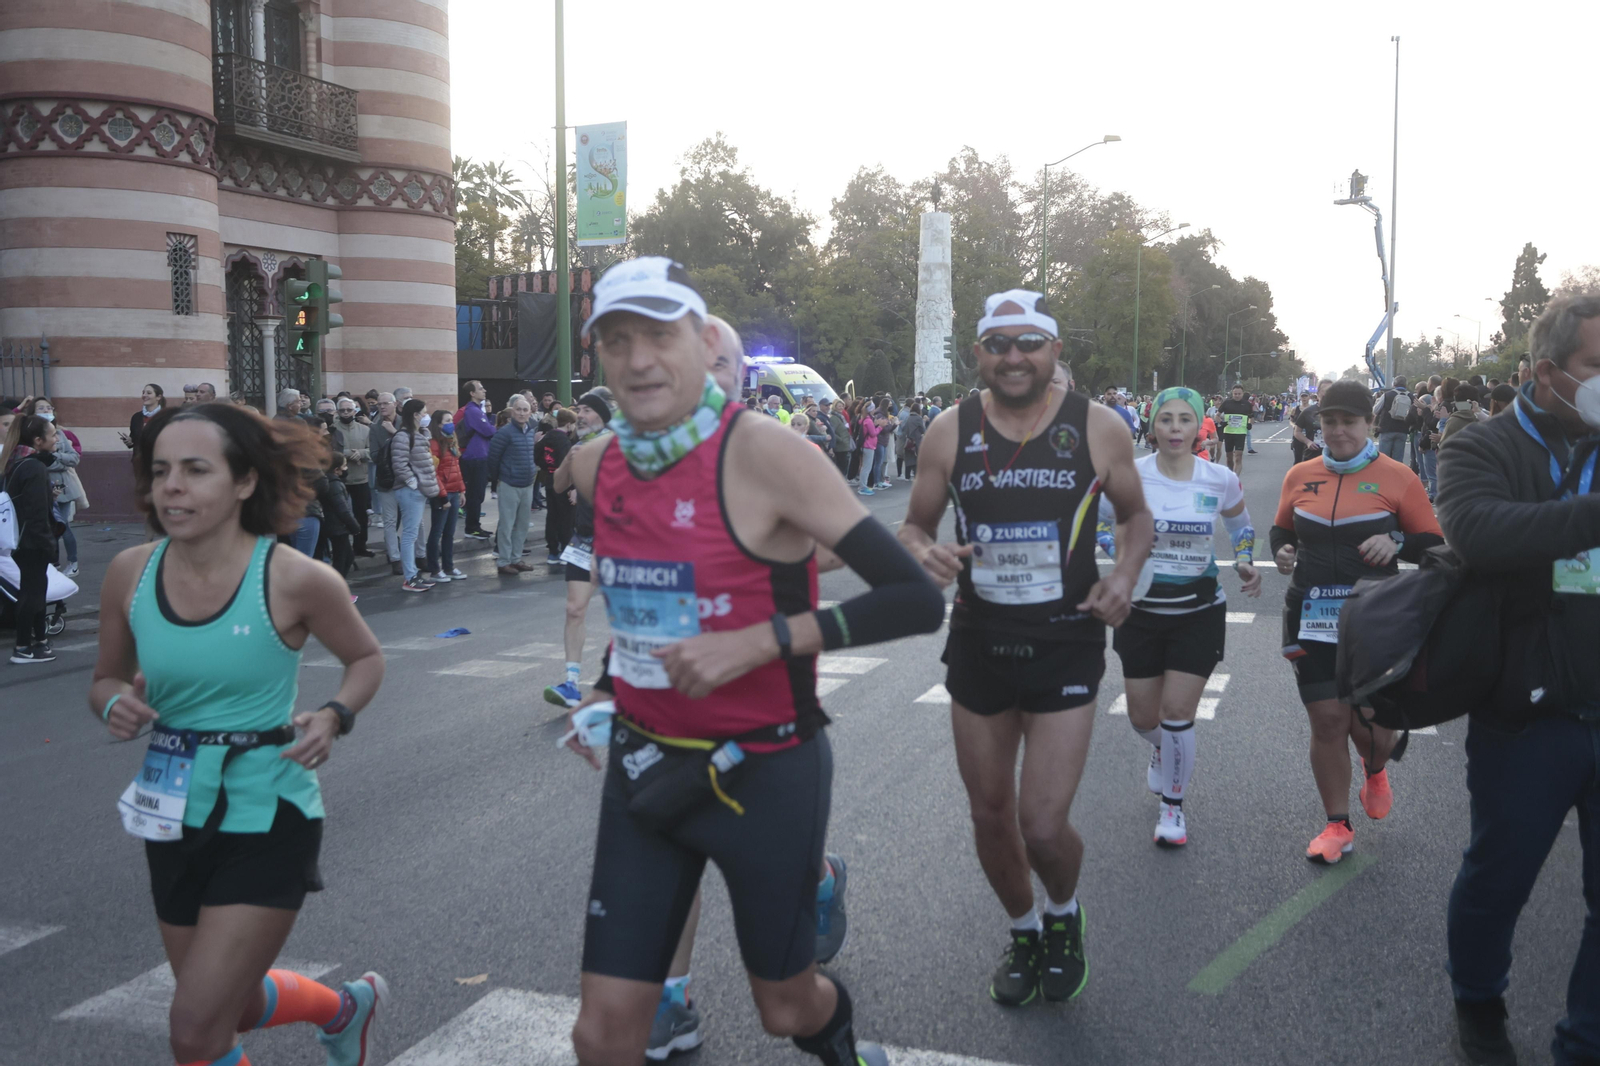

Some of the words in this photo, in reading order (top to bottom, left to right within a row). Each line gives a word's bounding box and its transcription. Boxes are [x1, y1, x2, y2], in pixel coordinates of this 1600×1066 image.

[961, 470, 986, 492] LOS
[993, 467, 1076, 490] JARTIBLES
[994, 526, 1048, 540] ZURICH
[1170, 523, 1207, 533] ZURICH
[1169, 540, 1192, 549] 9449
[997, 553, 1028, 566] 9460
[1180, 554, 1207, 563] LAMINE
[617, 565, 678, 587] ZURICH
[1321, 588, 1353, 597] ZURIC
